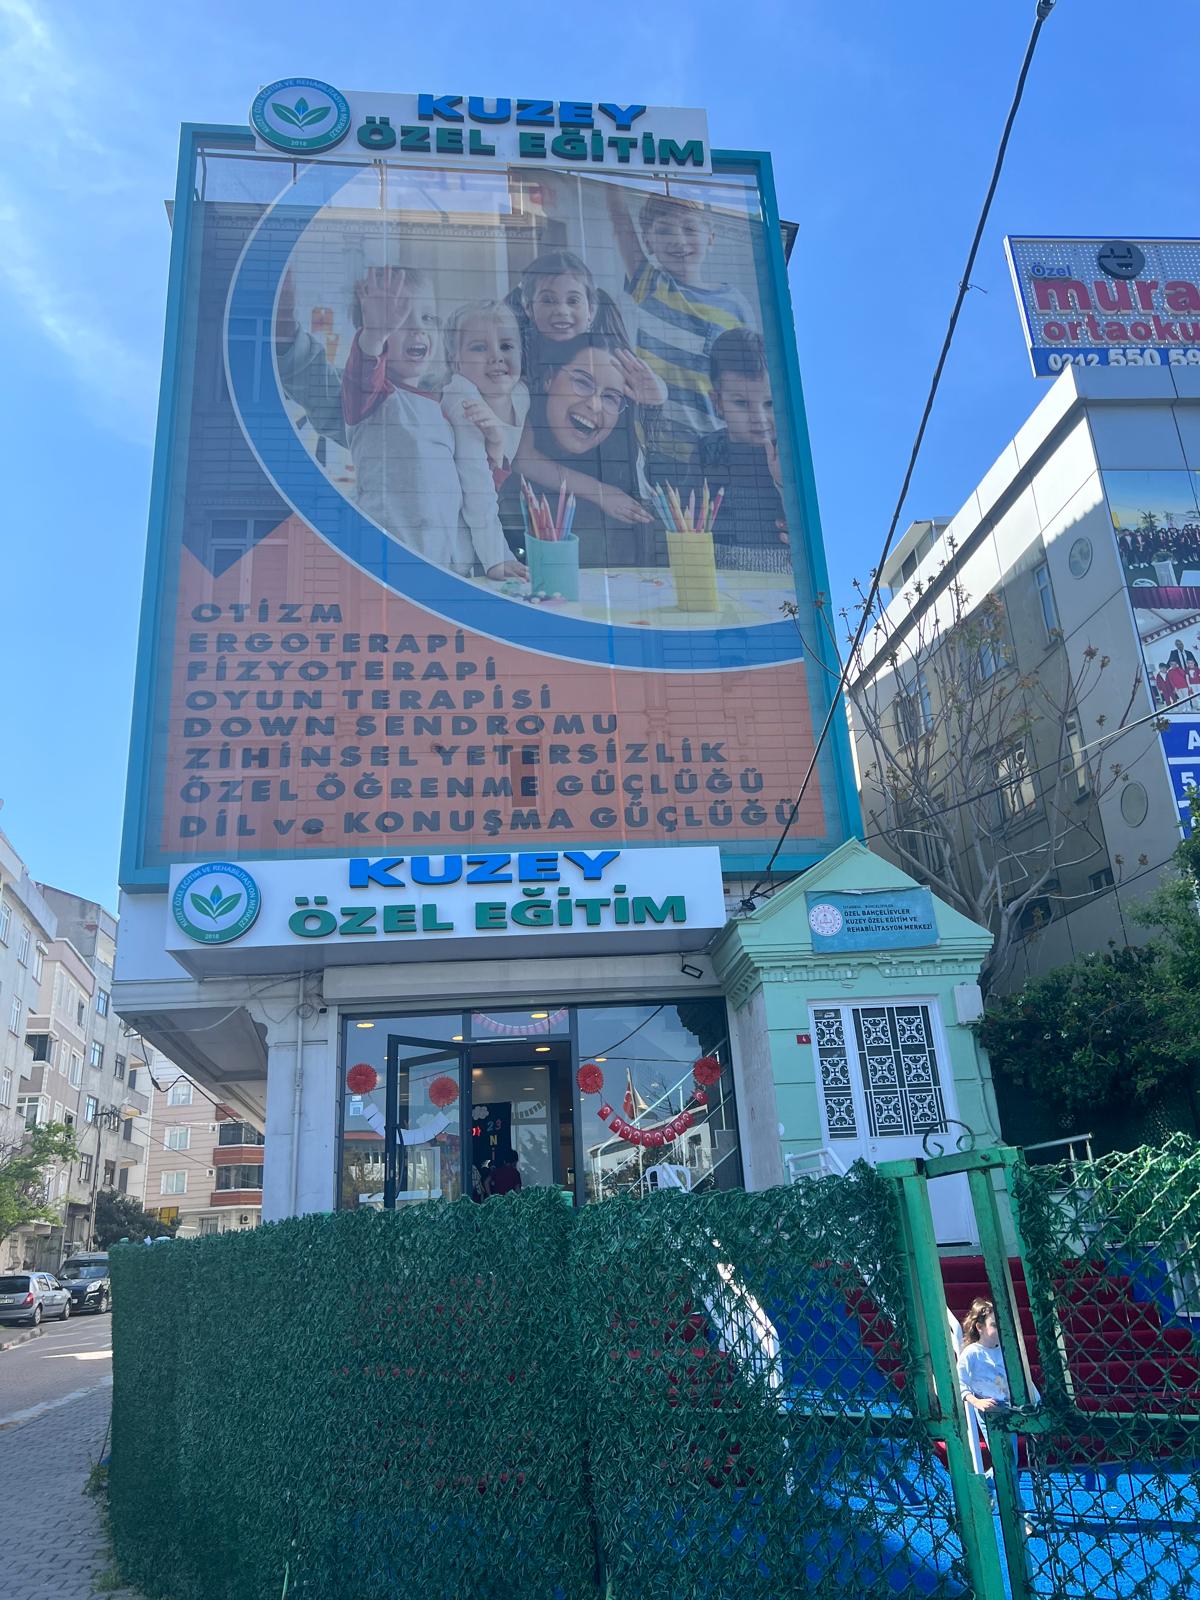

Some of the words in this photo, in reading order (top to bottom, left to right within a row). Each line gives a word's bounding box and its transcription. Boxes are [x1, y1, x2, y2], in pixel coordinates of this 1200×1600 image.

[418, 93, 646, 131] KUZEY
[357, 116, 495, 156] ÖZEL
[519, 127, 704, 167] EĞİTİM
[1031, 262, 1072, 278] Özel
[1108, 348, 1161, 366] 550
[191, 599, 342, 623] OTİZM
[188, 629, 465, 654] ERGOTERAPİ
[187, 655, 497, 682] FİZYOTERAPİ
[185, 689, 323, 711] OYUN
[342, 684, 551, 711] TERAPİSİ
[184, 716, 335, 738] DOWN
[355, 714, 617, 737] SENDROMU
[183, 741, 418, 770] ZİHİNSEL
[436, 737, 728, 766] YETERSİZLİK
[180, 775, 298, 804] ÖZEL
[316, 772, 539, 800] ÖĞRENME
[556, 767, 765, 801] GÜÇLÜĞÜ
[179, 809, 256, 838] DİL
[273, 818, 324, 835] ve
[344, 807, 573, 837] KONUŞMA
[590, 798, 800, 832] GÜÇLÜĞÜ
[349, 850, 620, 888] KUZEY
[289, 895, 454, 938] ÖZEL
[475, 884, 686, 930] EĞİTİM
[844, 909, 861, 917] ÖZEL
[867, 916, 884, 924] ÖZEL
[886, 915, 908, 923] EĞİTİM
[846, 924, 903, 933] REHABİLİTASYON
[904, 922, 933, 931] MERKEZİ
